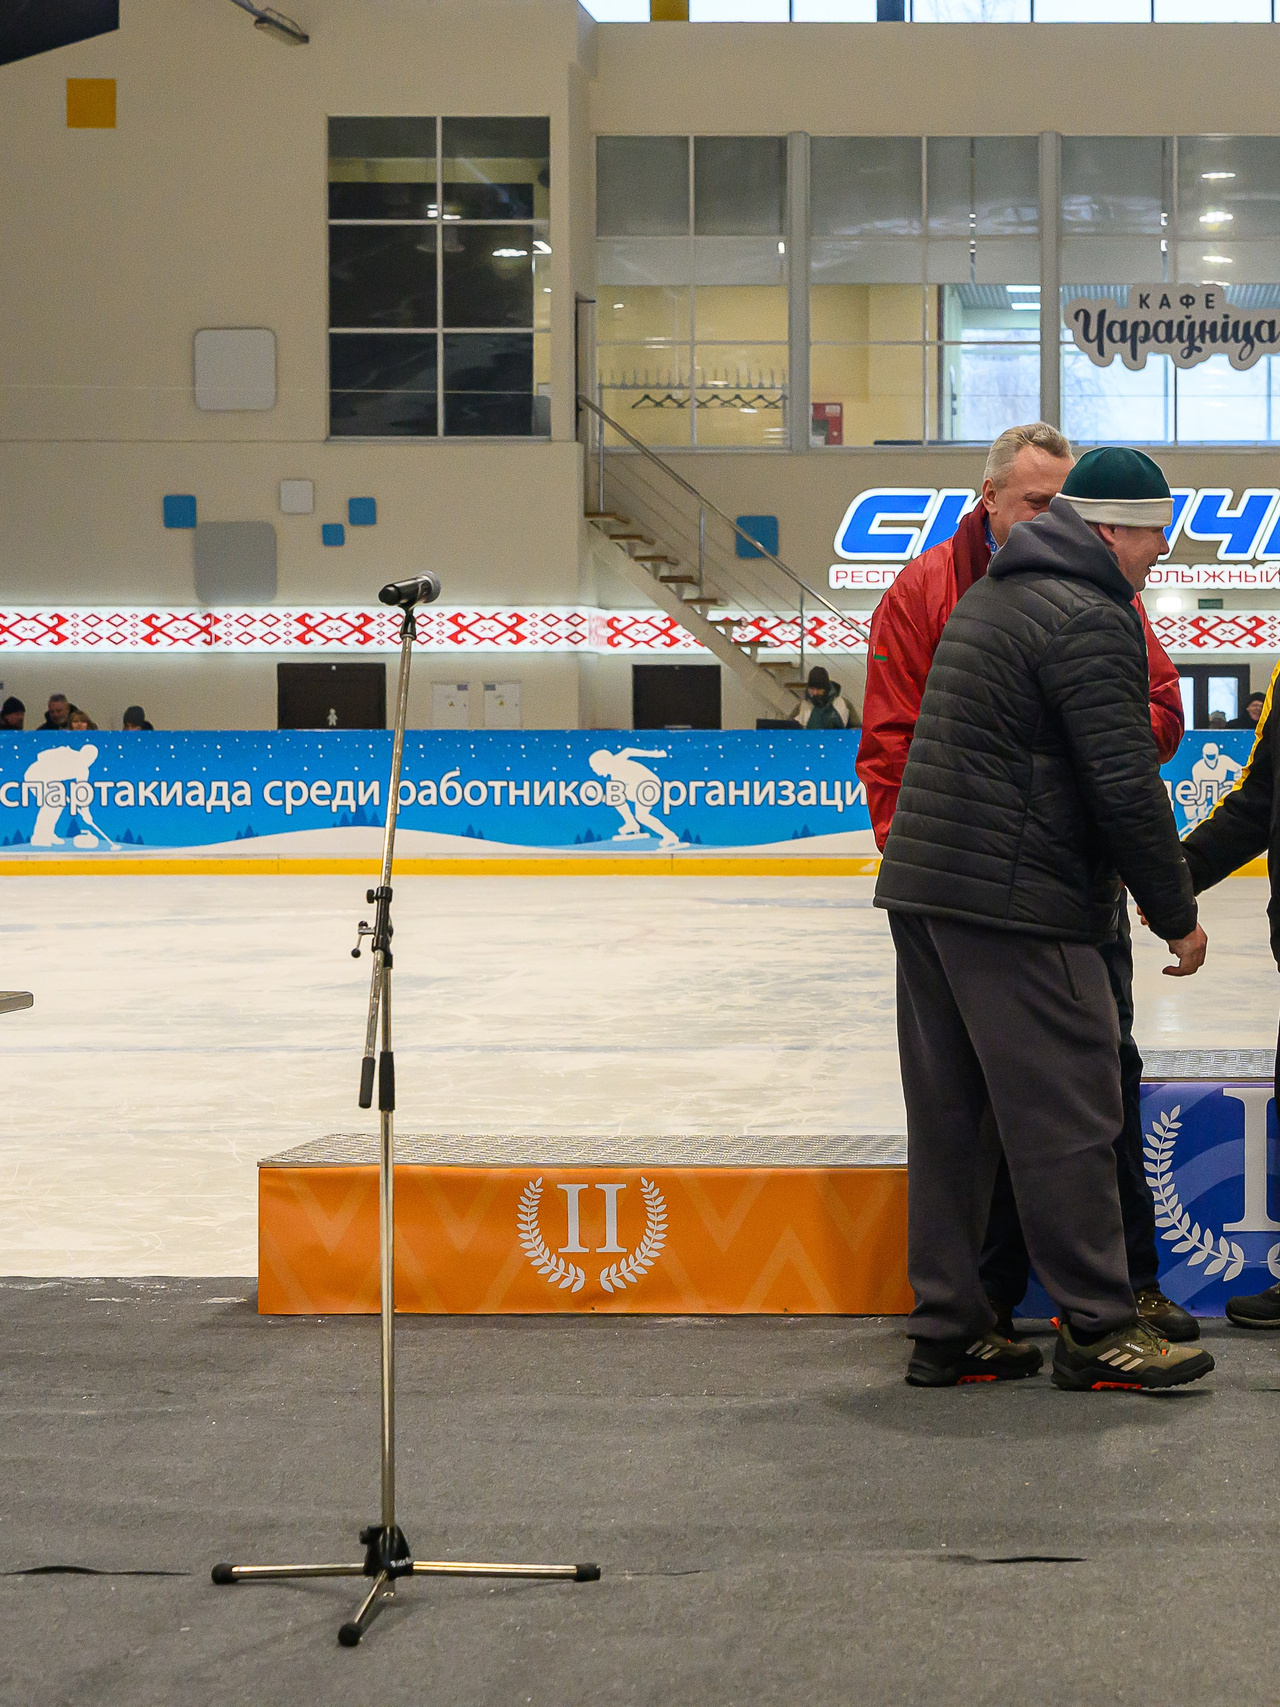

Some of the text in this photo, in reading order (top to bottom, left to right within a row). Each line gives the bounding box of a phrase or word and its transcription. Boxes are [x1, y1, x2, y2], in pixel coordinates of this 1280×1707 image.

[1139, 293, 1216, 310] КАФЕ
[0, 779, 252, 815] спартакиада
[263, 779, 381, 815] среди
[396, 770, 627, 815] работников
[556, 1183, 628, 1253] II
